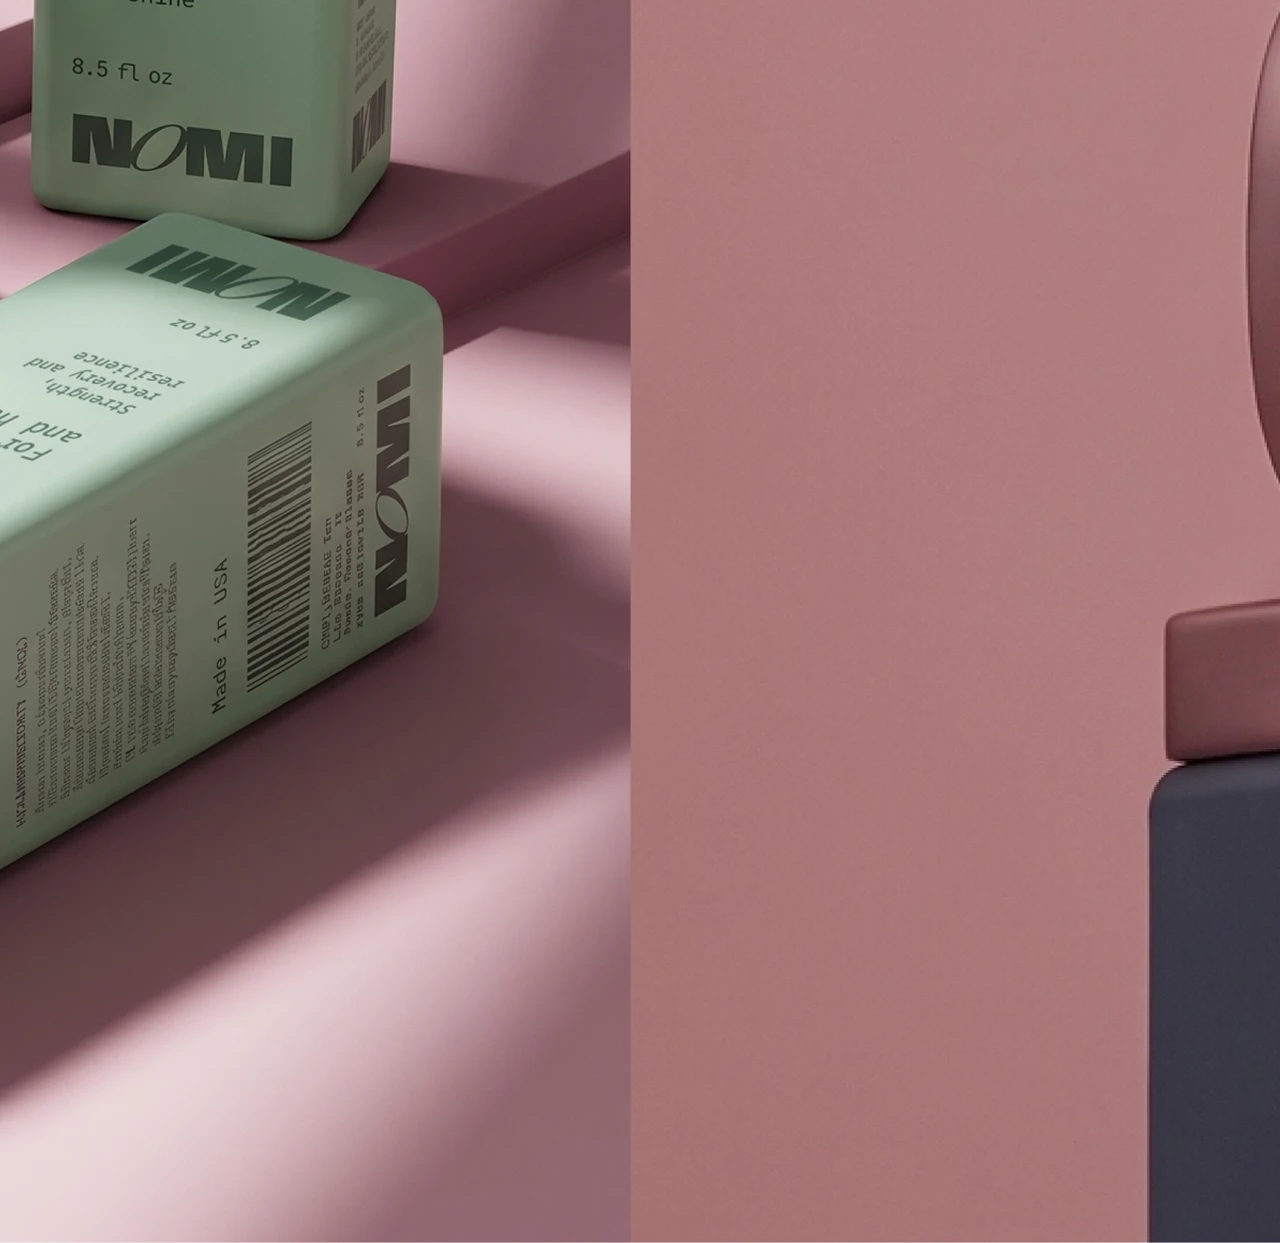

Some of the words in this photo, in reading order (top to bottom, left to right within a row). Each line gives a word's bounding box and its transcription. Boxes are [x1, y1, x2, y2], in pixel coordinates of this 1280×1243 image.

[71, 57, 109, 78] 8.5
[117, 62, 140, 82] fl
[148, 70, 174, 86] oz
[71, 113, 294, 188] NOMI
[124, 243, 352, 322] NOMI
[169, 318, 197, 331] oz
[196, 325, 222, 339] fl
[219, 333, 261, 350] 8.5
[22, 357, 66, 373] and
[73, 350, 186, 389] resilience
[45, 378, 137, 415] Strength,
[68, 368, 162, 401] recovery
[19, 420, 83, 444] and
[374, 362, 411, 617] NOMI
[213, 556, 228, 604] USA
[213, 613, 227, 643] in
[211, 655, 227, 714] Made
